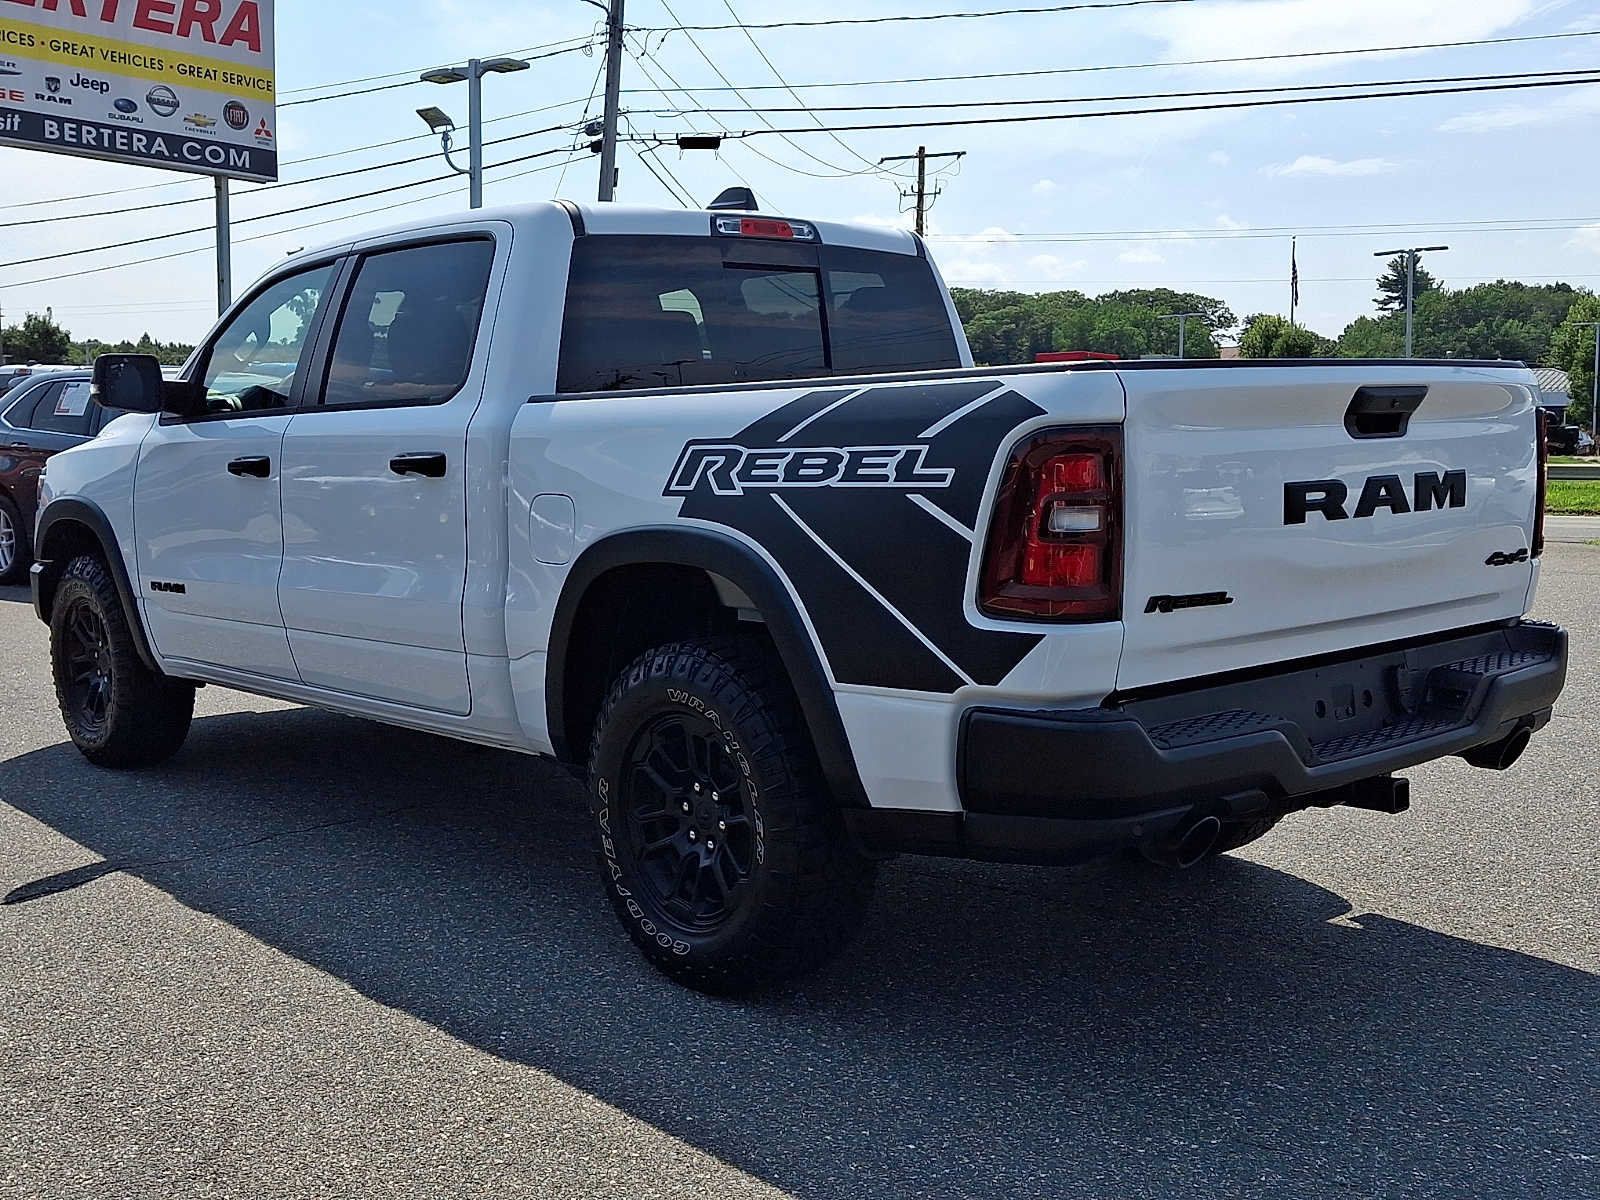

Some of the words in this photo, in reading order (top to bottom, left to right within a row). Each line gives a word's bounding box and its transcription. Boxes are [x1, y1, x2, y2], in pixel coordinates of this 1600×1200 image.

[0, 30, 35, 47] ICES
[49, 40, 95, 58] GREAT
[100, 48, 164, 71] VEHICLES
[177, 63, 218, 81] GREAT
[222, 72, 273, 92] SERVICE
[70, 73, 110, 94] Jeep
[34, 93, 73, 105] RAM
[108, 113, 144, 123] SUBARU
[229, 109, 244, 124] FIAT
[44, 119, 251, 169] BERTERA.COM
[669, 444, 955, 496] REBEL
[1283, 468, 1466, 525] RAM
[150, 581, 186, 594] RAM
[1143, 591, 1234, 613] REBEL
[598, 777, 691, 956] GOODYEAR
